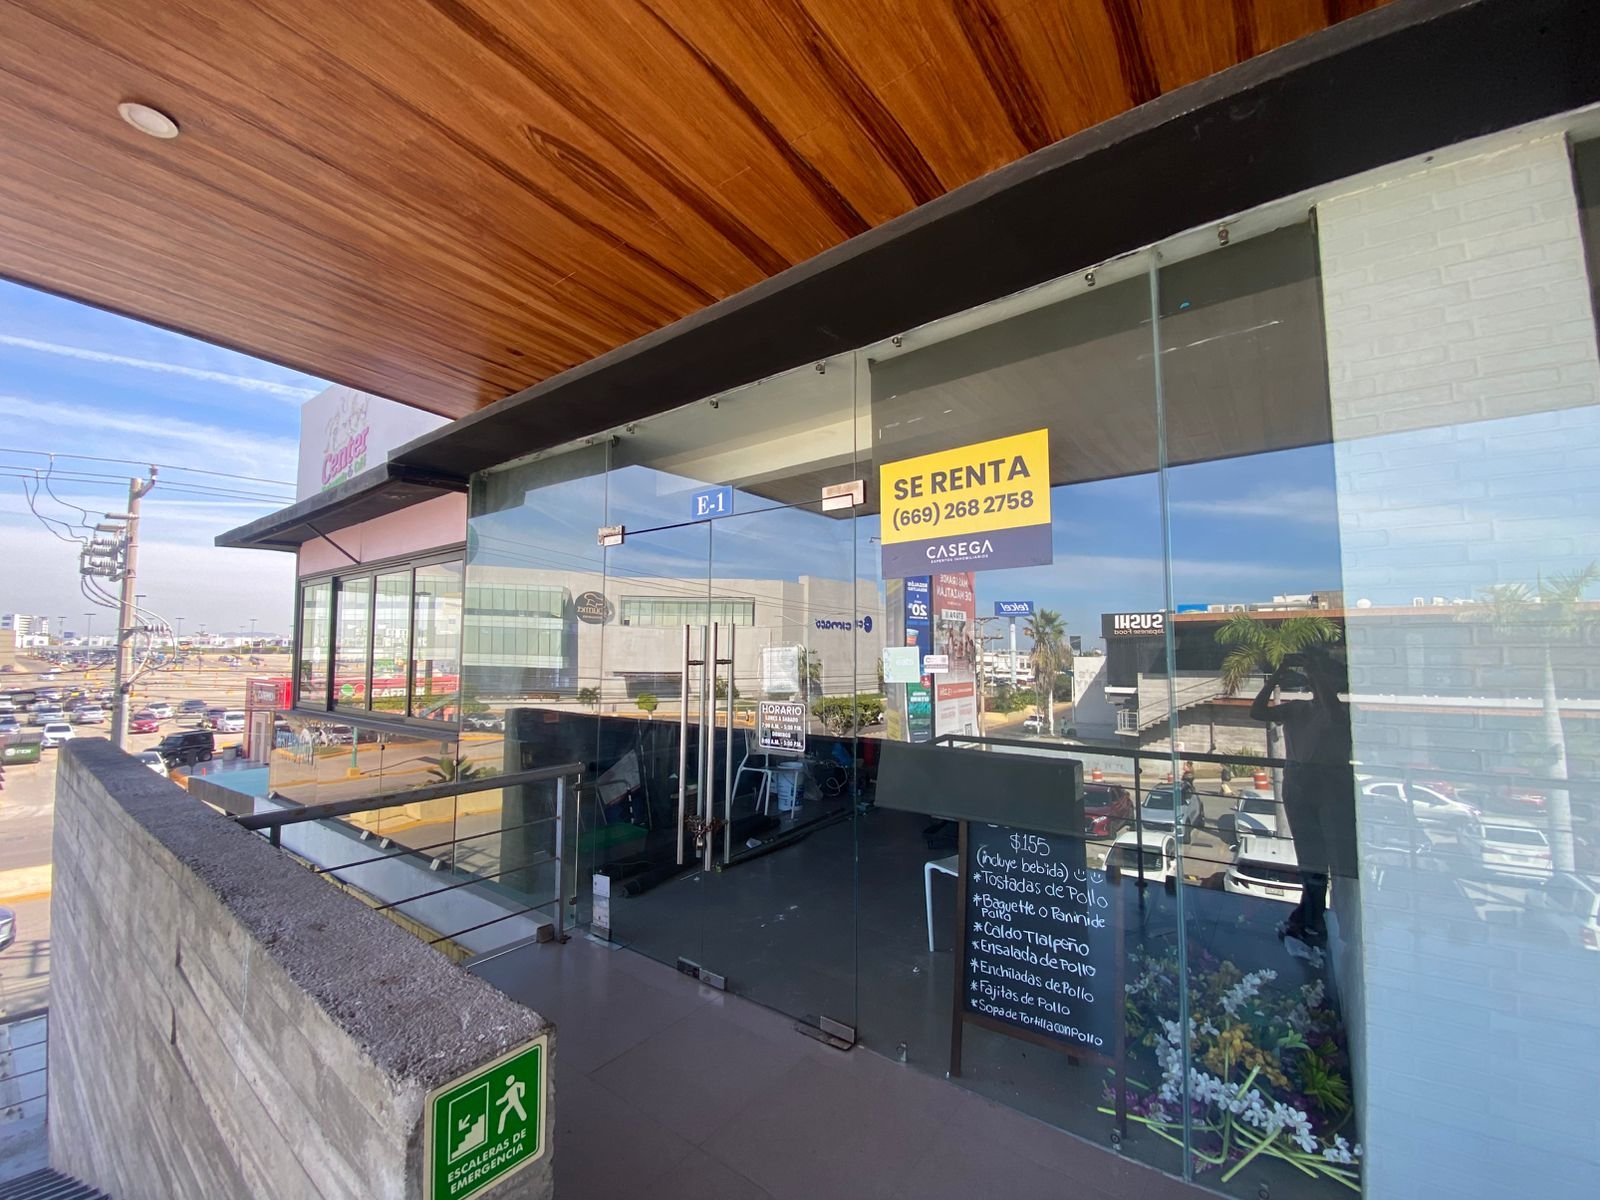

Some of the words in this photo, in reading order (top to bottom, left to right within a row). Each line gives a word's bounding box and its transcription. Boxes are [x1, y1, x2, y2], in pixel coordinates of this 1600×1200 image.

[322, 426, 369, 485] Center
[894, 474, 924, 501] SE
[930, 455, 1031, 494] RENTA
[696, 493, 724, 516] E-1
[892, 502, 940, 531] (669)
[944, 498, 979, 522] 268
[984, 490, 1034, 514] 2758
[926, 540, 993, 558] CASEGA
[763, 705, 802, 716] HORARIO
[1010, 833, 1050, 856] $155
[977, 844, 1017, 872] (incluye
[1022, 858, 1068, 882] bebida)
[981, 871, 1040, 894] Tostadas
[1045, 883, 1064, 898] de
[1066, 886, 1108, 908] Pollo
[982, 894, 1035, 915] Baguette
[1039, 907, 1048, 918] o
[984, 922, 1022, 939] Caldo
[1023, 930, 1089, 956] Tlalpeño
[981, 940, 1037, 964] Ensalada
[1040, 953, 1058, 969] de
[1059, 959, 1096, 976] Pollo
[980, 960, 1042, 987] Enchiladas
[1045, 978, 1061, 993] de
[1062, 982, 1094, 1002] Pollo
[980, 980, 1018, 1000] Fajitas
[1021, 992, 1034, 1005] de
[1038, 997, 1070, 1015] Pollo
[448, 1137, 510, 1183] ESCALERAS
[512, 1128, 526, 1144] DE
[451, 1143, 523, 1194] EMERGENCIA
